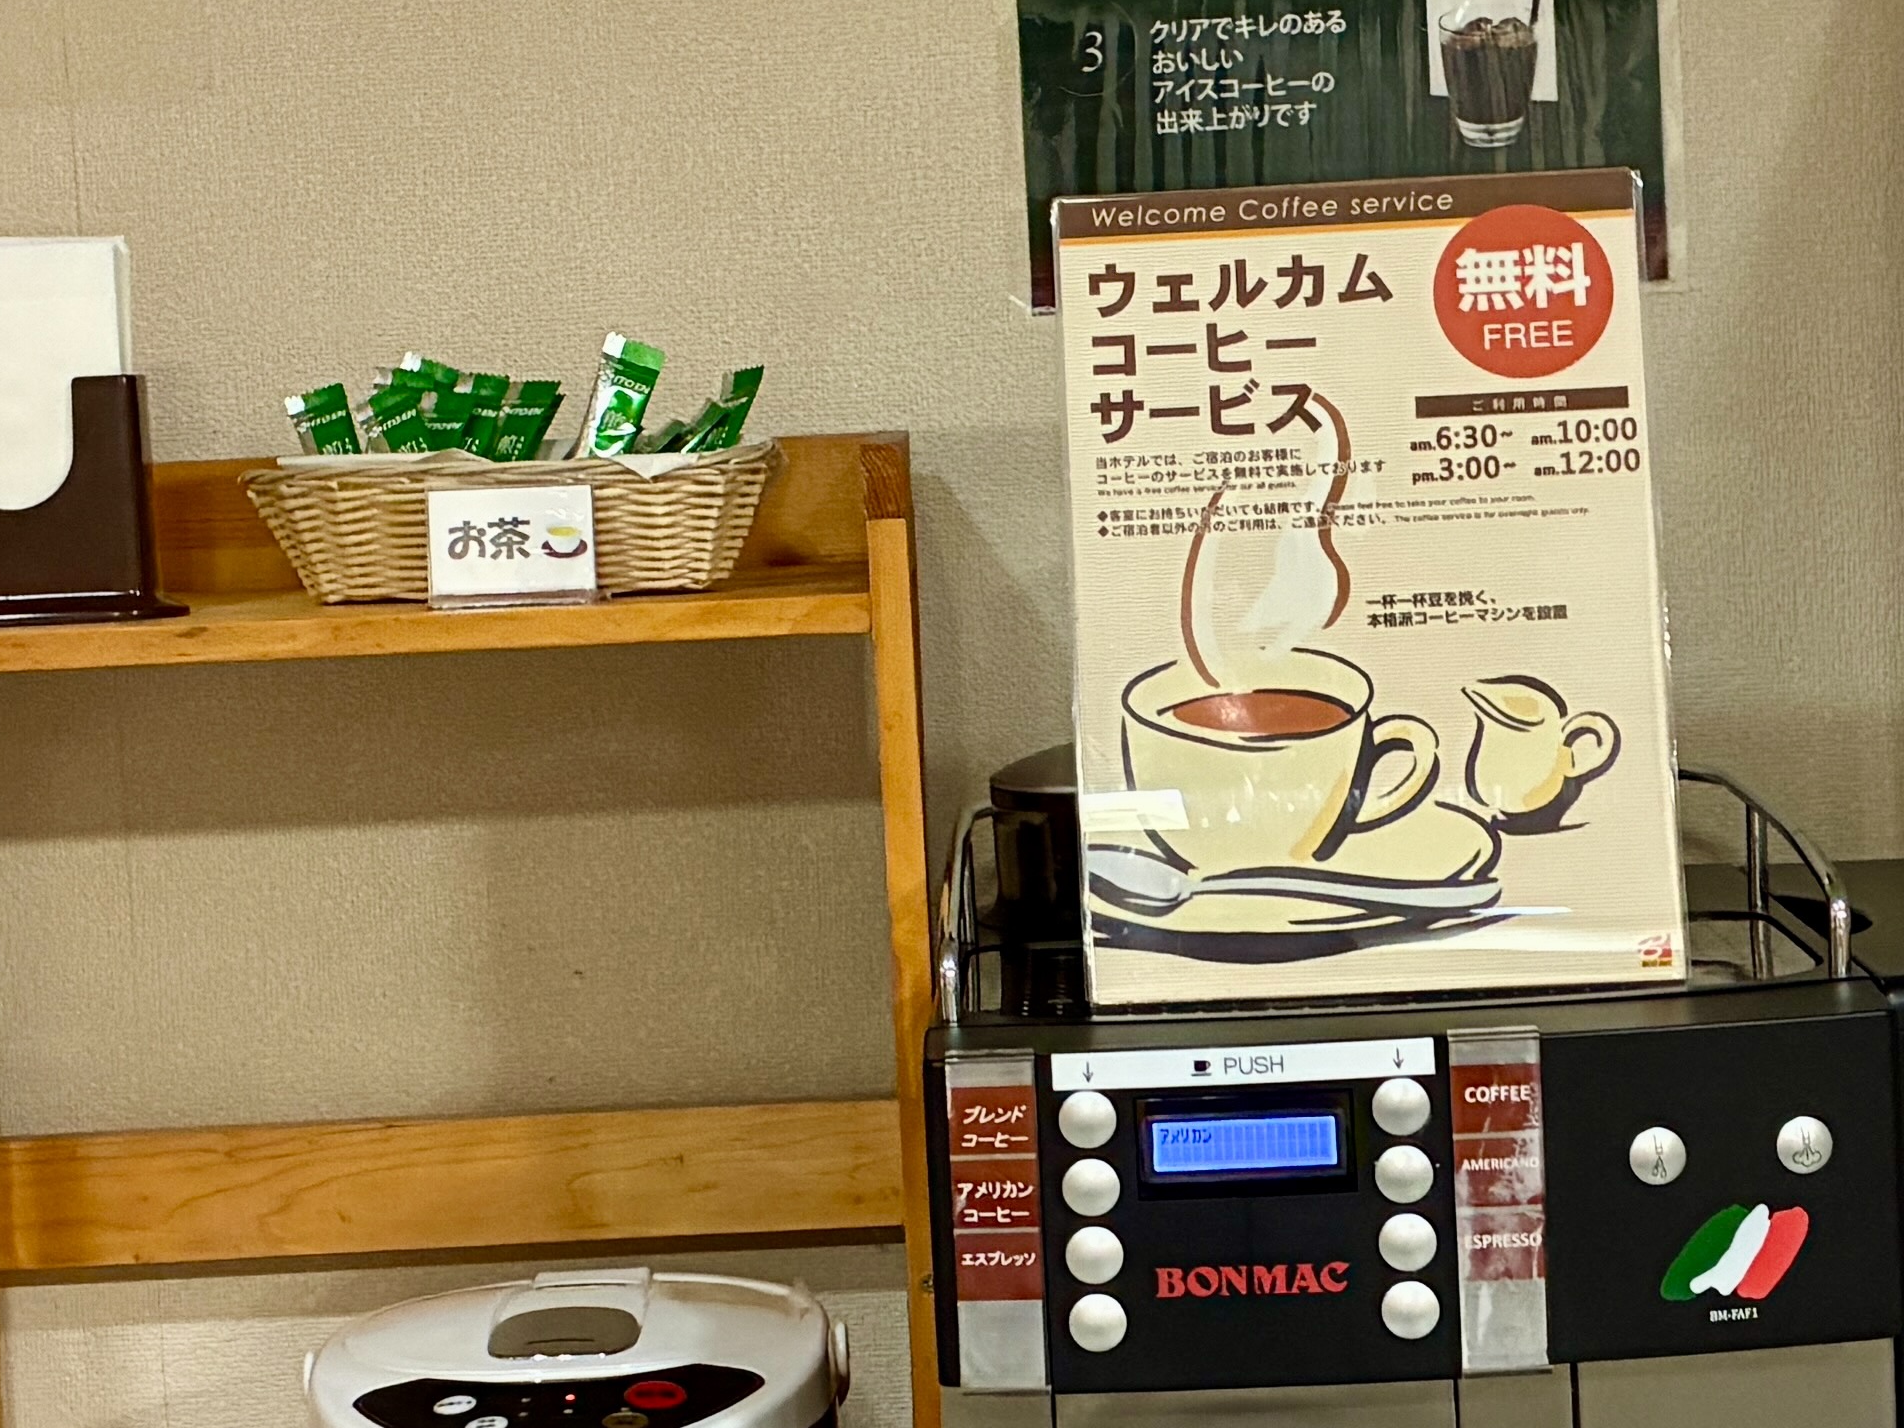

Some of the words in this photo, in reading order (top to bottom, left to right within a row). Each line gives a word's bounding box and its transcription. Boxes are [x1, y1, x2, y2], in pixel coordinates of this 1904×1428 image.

[1148, 9, 1348, 41] クリアでキレのある
[1079, 30, 1105, 73] 3
[1152, 46, 1244, 74] おいしい
[1153, 71, 1336, 105] アイスコーヒーの
[1155, 102, 1318, 136] 出来上がりです
[1091, 200, 1227, 229] Welcome
[1238, 193, 1340, 222] Coffee
[1350, 189, 1455, 216] service
[1088, 252, 1394, 319] ウェルカム
[1454, 241, 1593, 313] 無料
[1091, 322, 1317, 377] コーヒー
[1482, 320, 1575, 351] FREE
[1090, 379, 1325, 445] サービス
[1096, 447, 1302, 472] 当ホテルでは、ご宿泊のお客様に
[448, 516, 531, 561] お茶
[1224, 1055, 1285, 1075] PUSH
[1464, 1084, 1532, 1104] COFFEE
[962, 1105, 1027, 1125] ブレンド
[961, 1134, 1029, 1149] コーヒー
[1461, 1156, 1540, 1172] AMERICANO
[957, 1181, 1035, 1200] アメリカン
[963, 1208, 1030, 1224] コーヒー
[1464, 1232, 1543, 1250] ESPRESSO
[961, 1252, 1037, 1267] エスプレッソ
[1154, 1261, 1351, 1299] BONMAC
